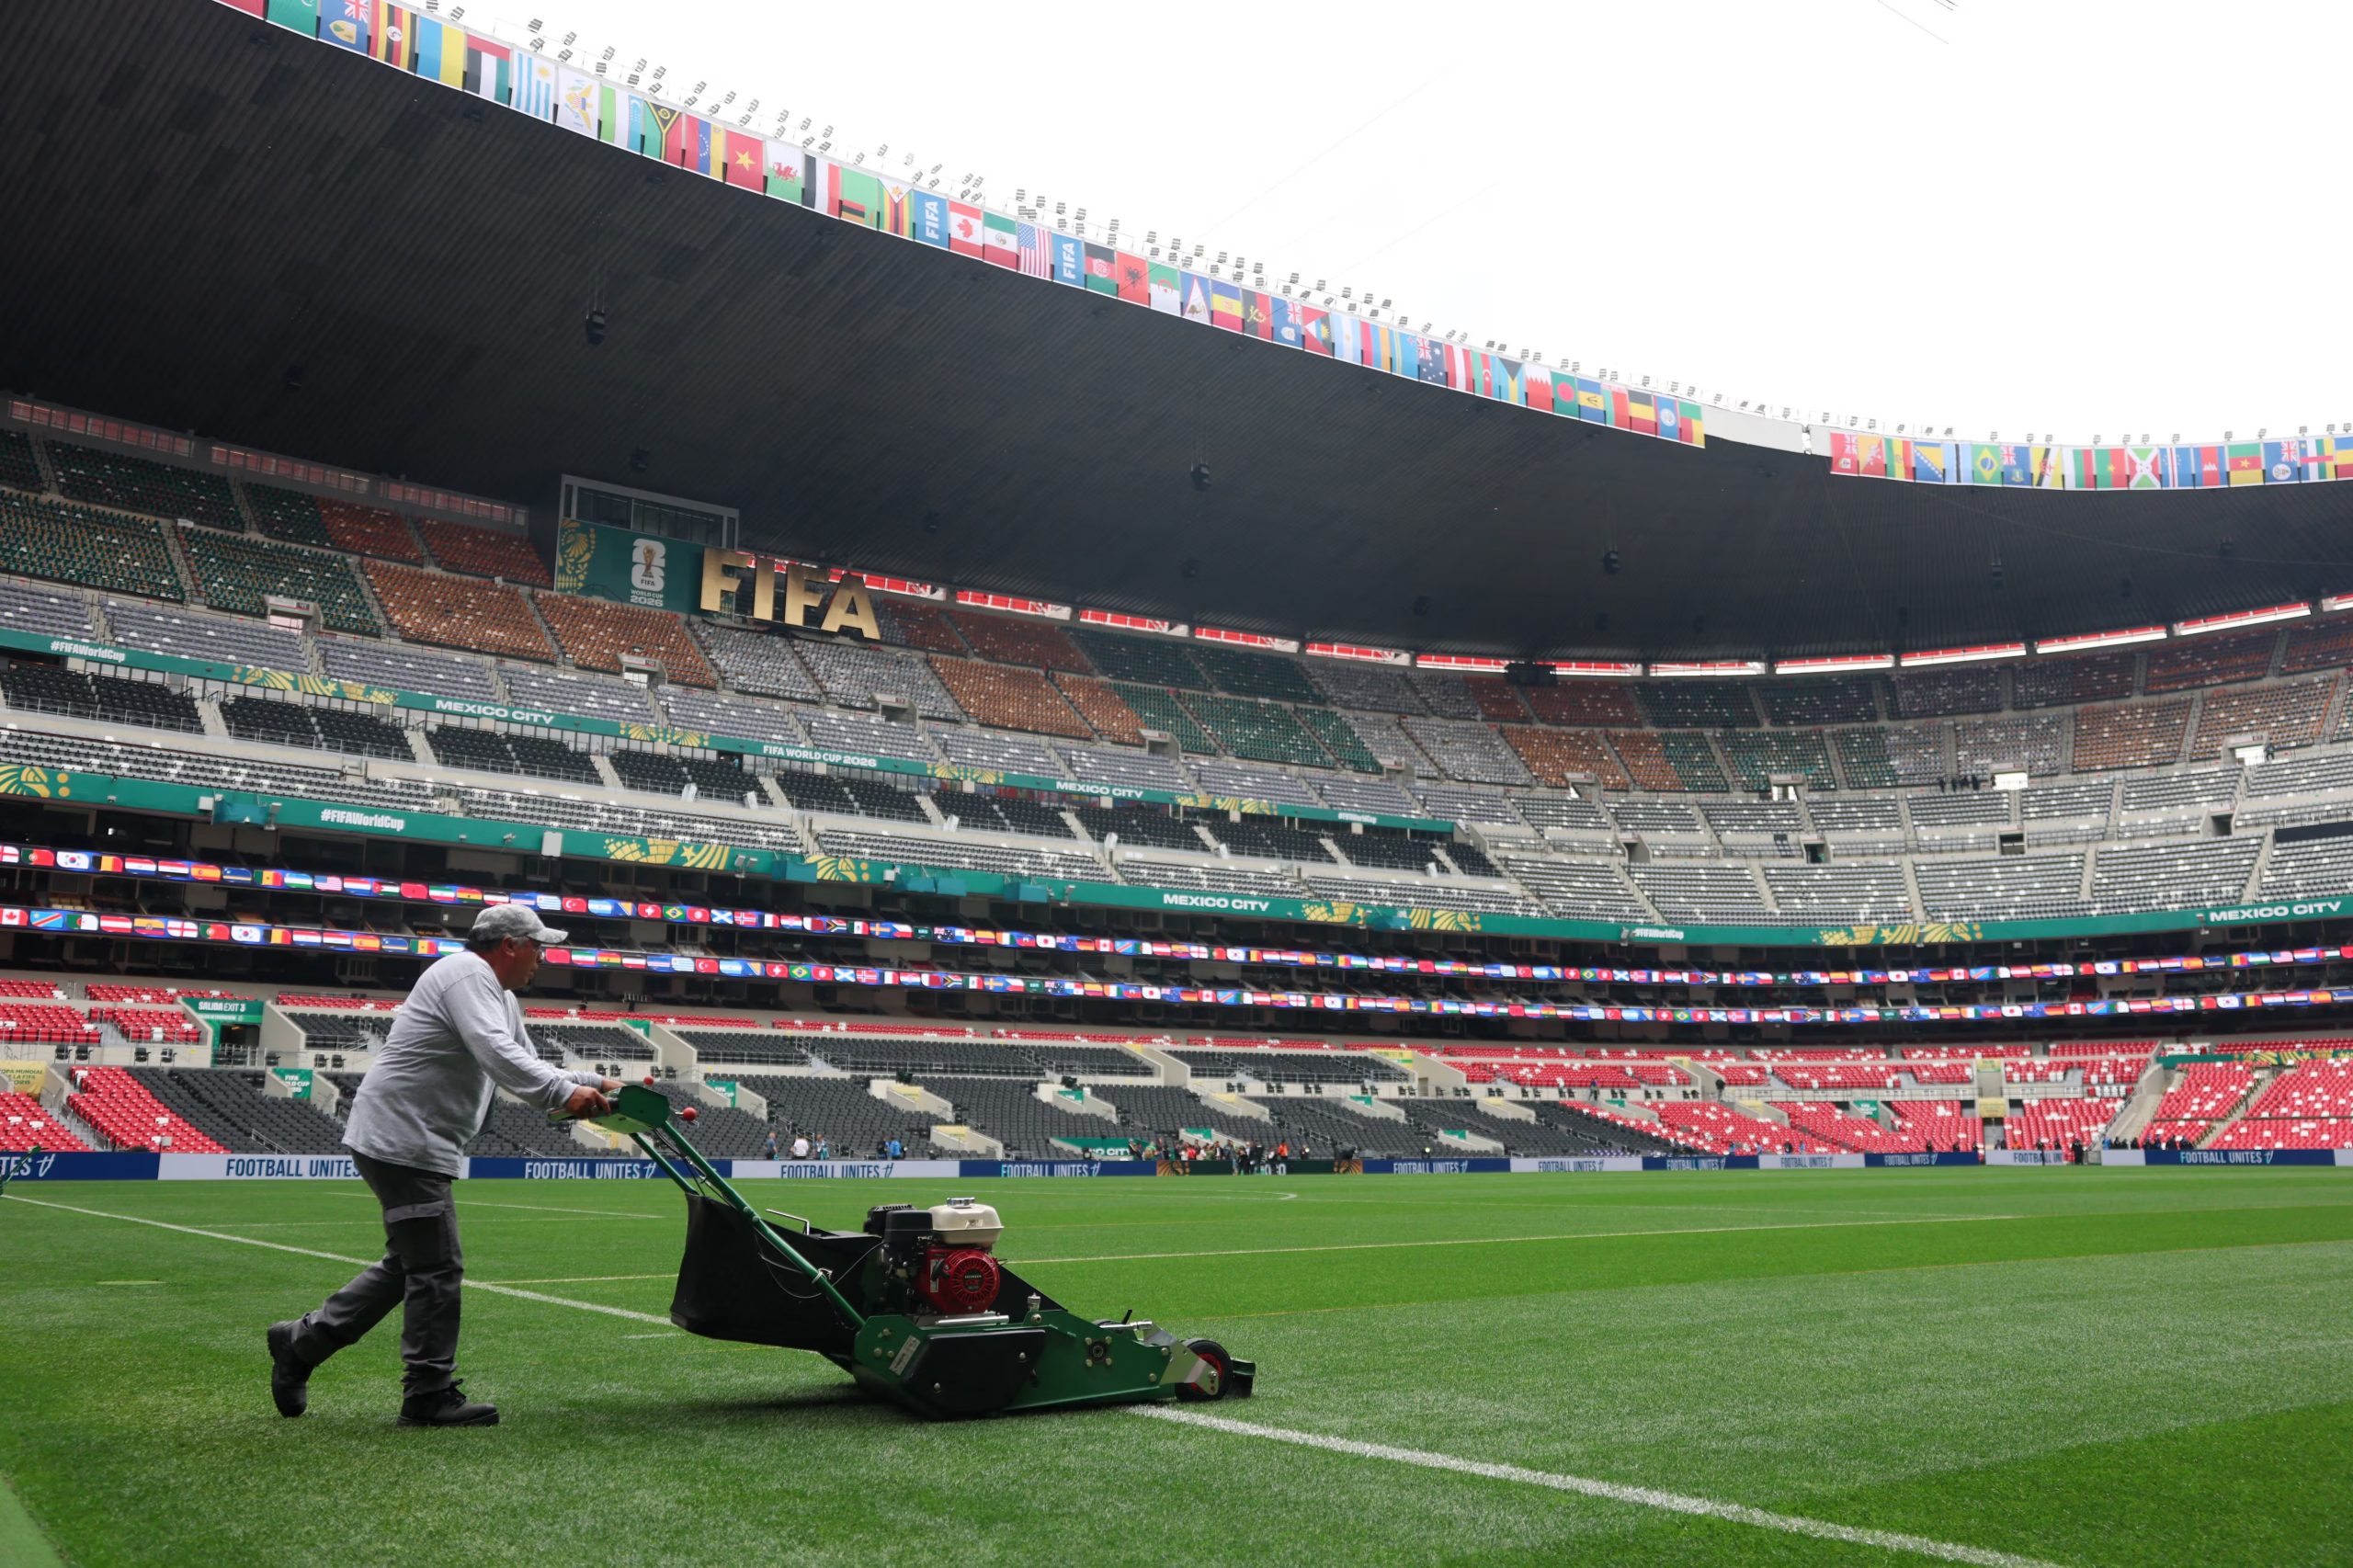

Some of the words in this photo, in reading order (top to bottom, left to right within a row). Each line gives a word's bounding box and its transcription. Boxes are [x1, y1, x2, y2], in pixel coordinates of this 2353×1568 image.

[925, 201, 939, 240] FIFA
[1062, 243, 1075, 279] FIFA
[630, 596, 665, 608] 2026
[631, 589, 652, 597] WORLD
[700, 547, 881, 641] FIFA
[50, 641, 126, 663] #FIFAWorldCup
[436, 699, 509, 718] MEXICO
[511, 710, 554, 725] CITY
[763, 744, 785, 756] FIFA
[786, 748, 821, 761] WORLD
[823, 753, 842, 763] CUP
[843, 756, 878, 767] 2026
[1055, 781, 1109, 795] MEXICO
[1111, 789, 1144, 799] CITY
[321, 809, 404, 832] #FIFAWorldCup
[1163, 893, 1230, 908] MEXICO
[1231, 899, 1270, 912] CITY
[2209, 906, 2290, 922] MEXICO
[2292, 901, 2342, 915] CITY
[198, 1002, 223, 1011] SALIDA
[224, 1003, 239, 1012] EXIT
[240, 1004, 246, 1012] 3
[226, 1158, 303, 1176] FOOTBALL
[1538, 1161, 1573, 1173] FOOTBALL
[1574, 1161, 1597, 1172] UNITES
[2180, 1152, 2226, 1164] FOOTBALL
[2228, 1152, 2263, 1164] UNITES
[524, 1162, 590, 1179] FOOTBALL
[595, 1163, 641, 1179] UNITES
[780, 1165, 835, 1178] FOOTBALL
[841, 1165, 880, 1178] UNITES
[1001, 1164, 1048, 1177] FOOTBALL
[1053, 1164, 1088, 1177] UNITES
[1393, 1162, 1430, 1174] FOOTBALL
[1433, 1162, 1459, 1174] UNITES
